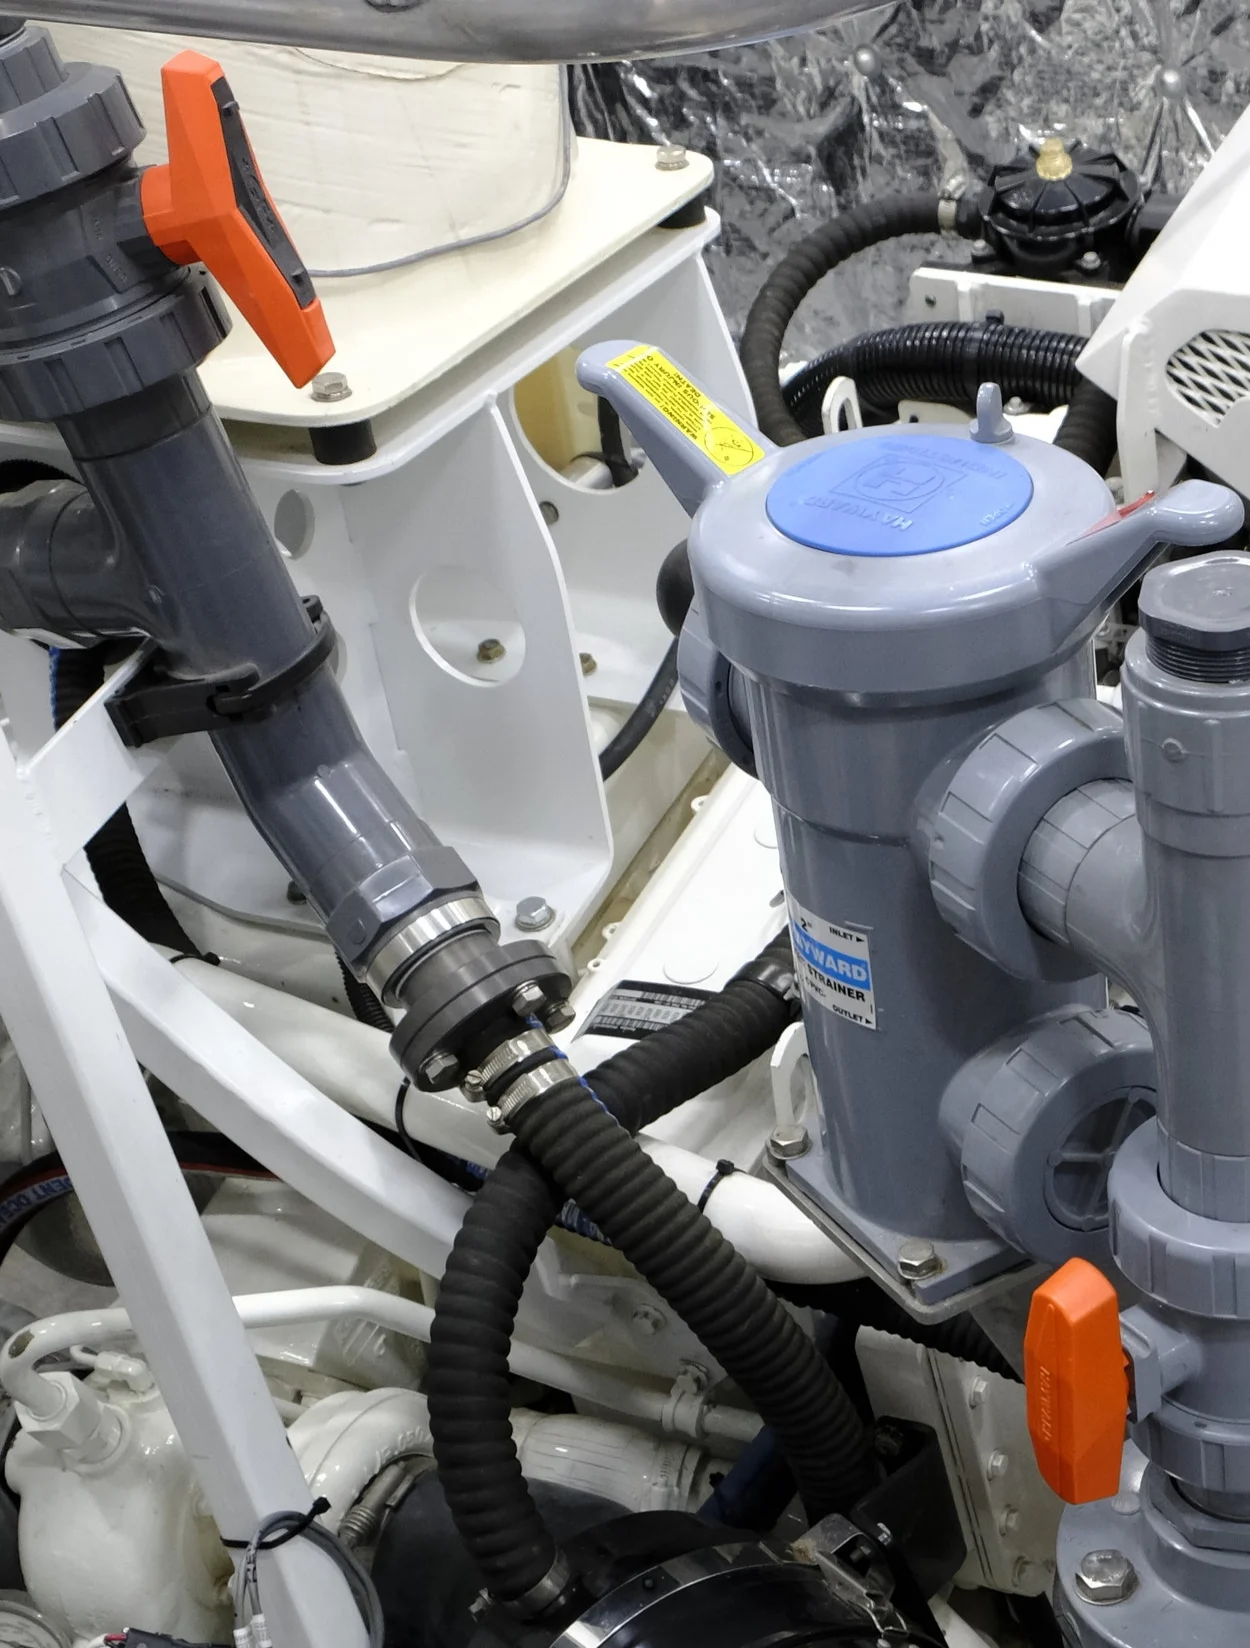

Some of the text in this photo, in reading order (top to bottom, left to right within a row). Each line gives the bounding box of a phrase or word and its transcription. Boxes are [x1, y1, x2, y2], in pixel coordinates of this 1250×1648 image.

[829, 926, 853, 941] INLET
[807, 964, 866, 1002] STRAINER
[832, 1004, 863, 1023] OUTLET
